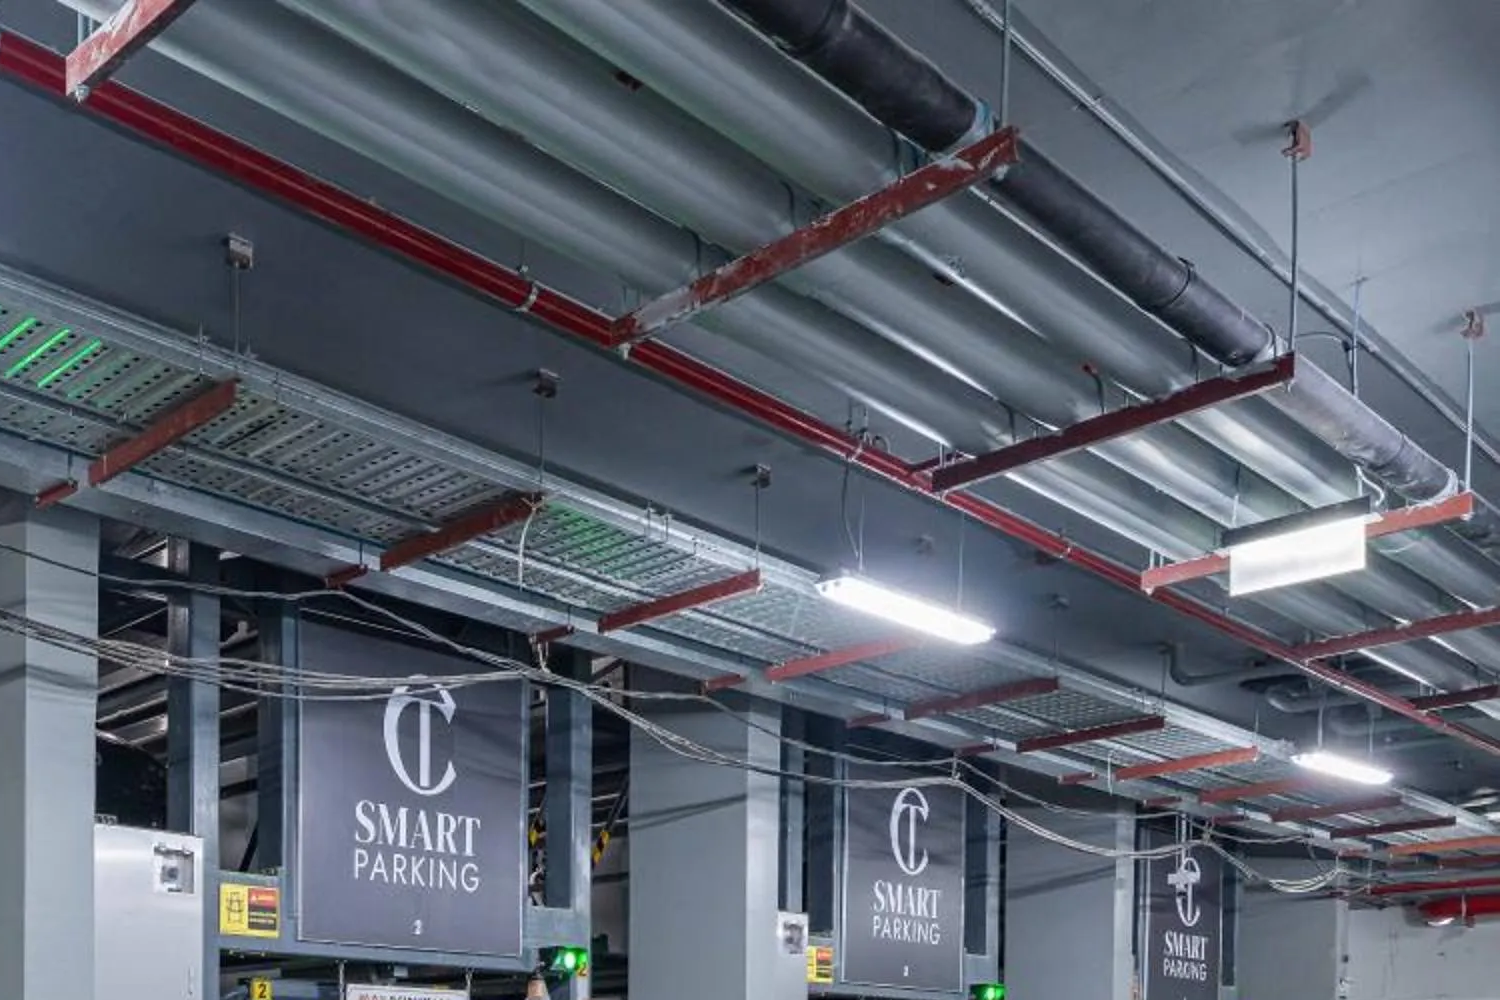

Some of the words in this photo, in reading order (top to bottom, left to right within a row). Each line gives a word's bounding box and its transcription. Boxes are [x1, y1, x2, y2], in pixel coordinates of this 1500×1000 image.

[354, 800, 481, 857] SMART
[353, 849, 480, 893] PARKING
[873, 879, 941, 919] SMART
[872, 915, 941, 945] PARKING
[1163, 929, 1209, 961] SMART
[258, 983, 267, 999] 2
